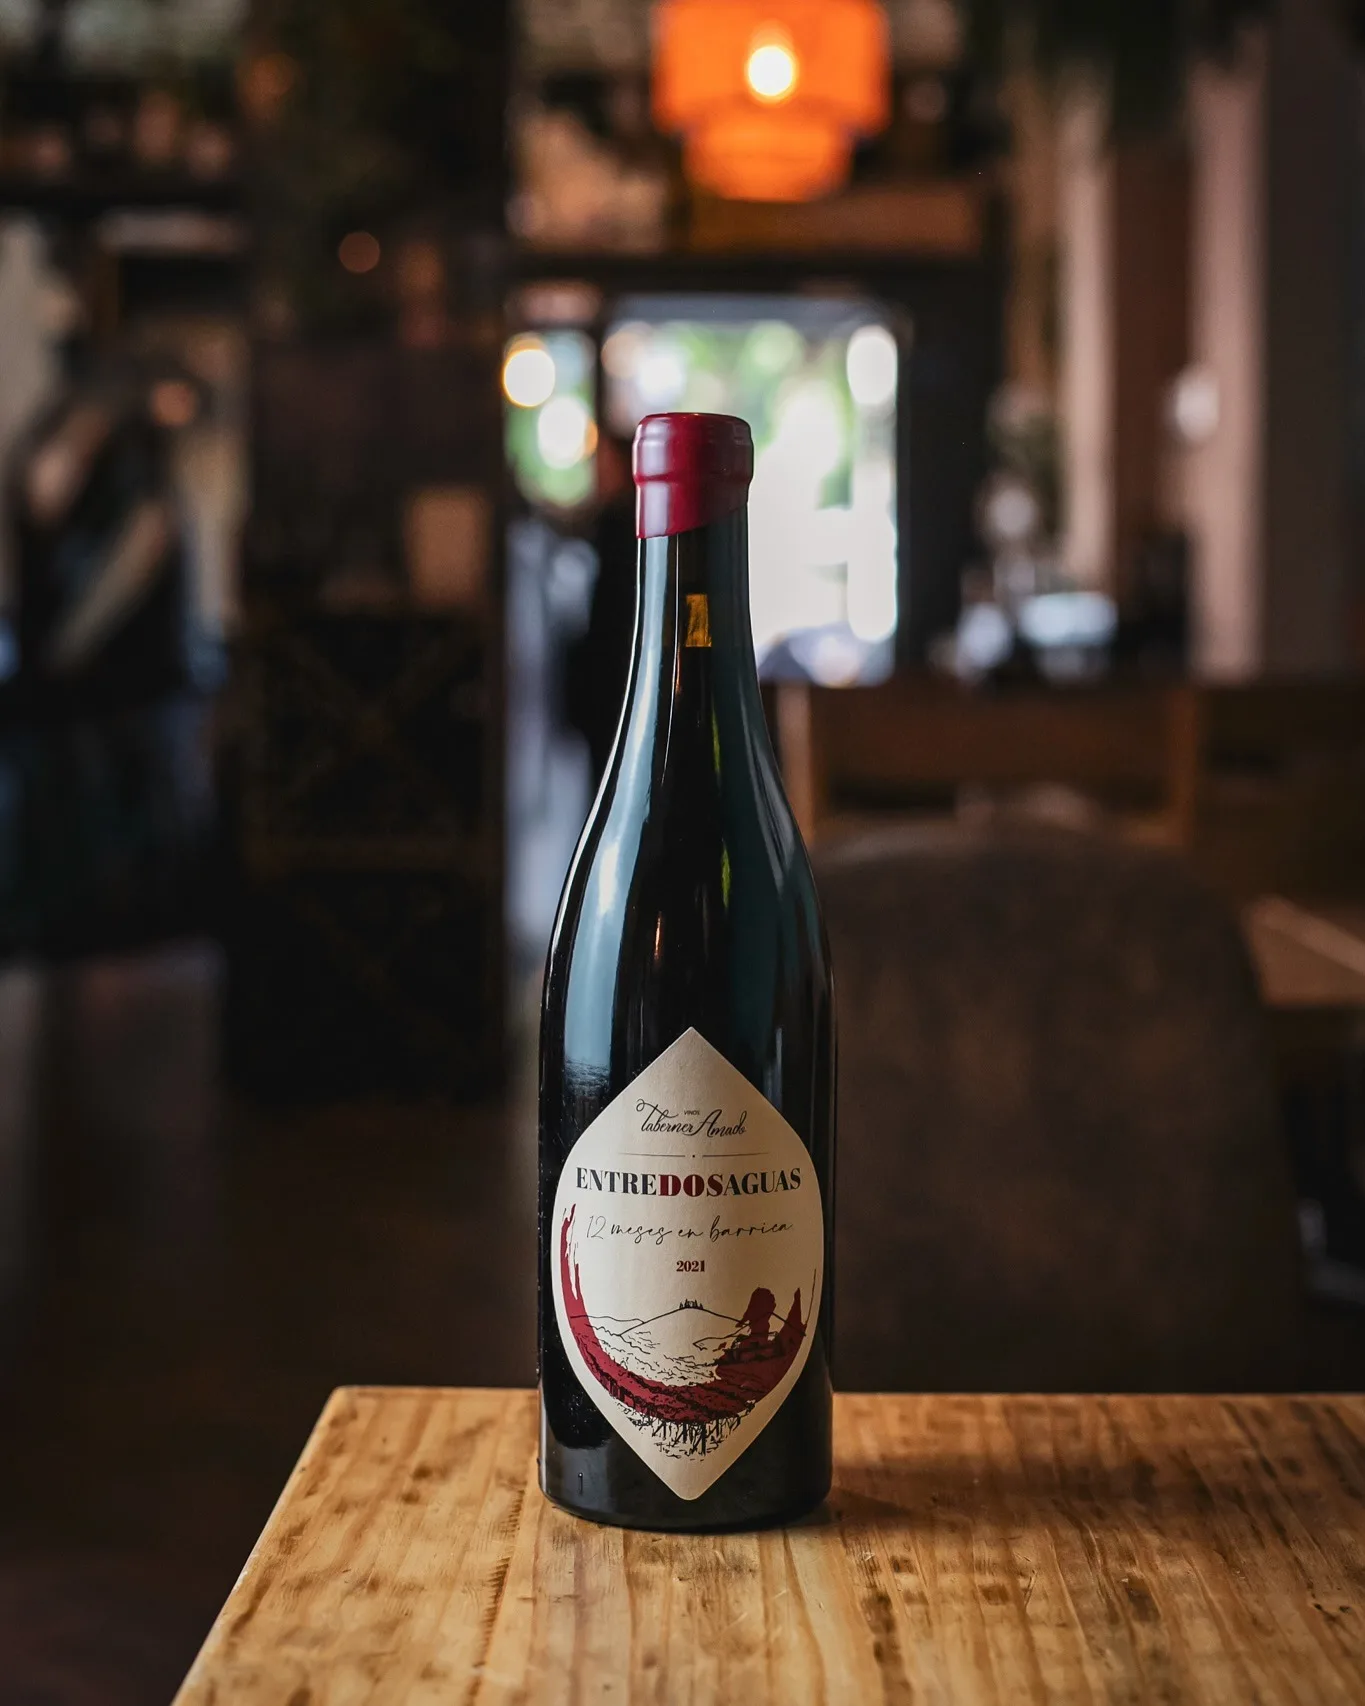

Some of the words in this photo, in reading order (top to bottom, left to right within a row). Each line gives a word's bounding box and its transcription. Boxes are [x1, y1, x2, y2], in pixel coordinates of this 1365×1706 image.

[636, 1098, 694, 1133] Taberner
[683, 1109, 747, 1138] Amado
[586, 1215, 607, 1240] 12
[610, 1222, 672, 1245] meses
[677, 1227, 703, 1239] en
[709, 1215, 793, 1243] barrica
[675, 1260, 706, 1273] 2021
